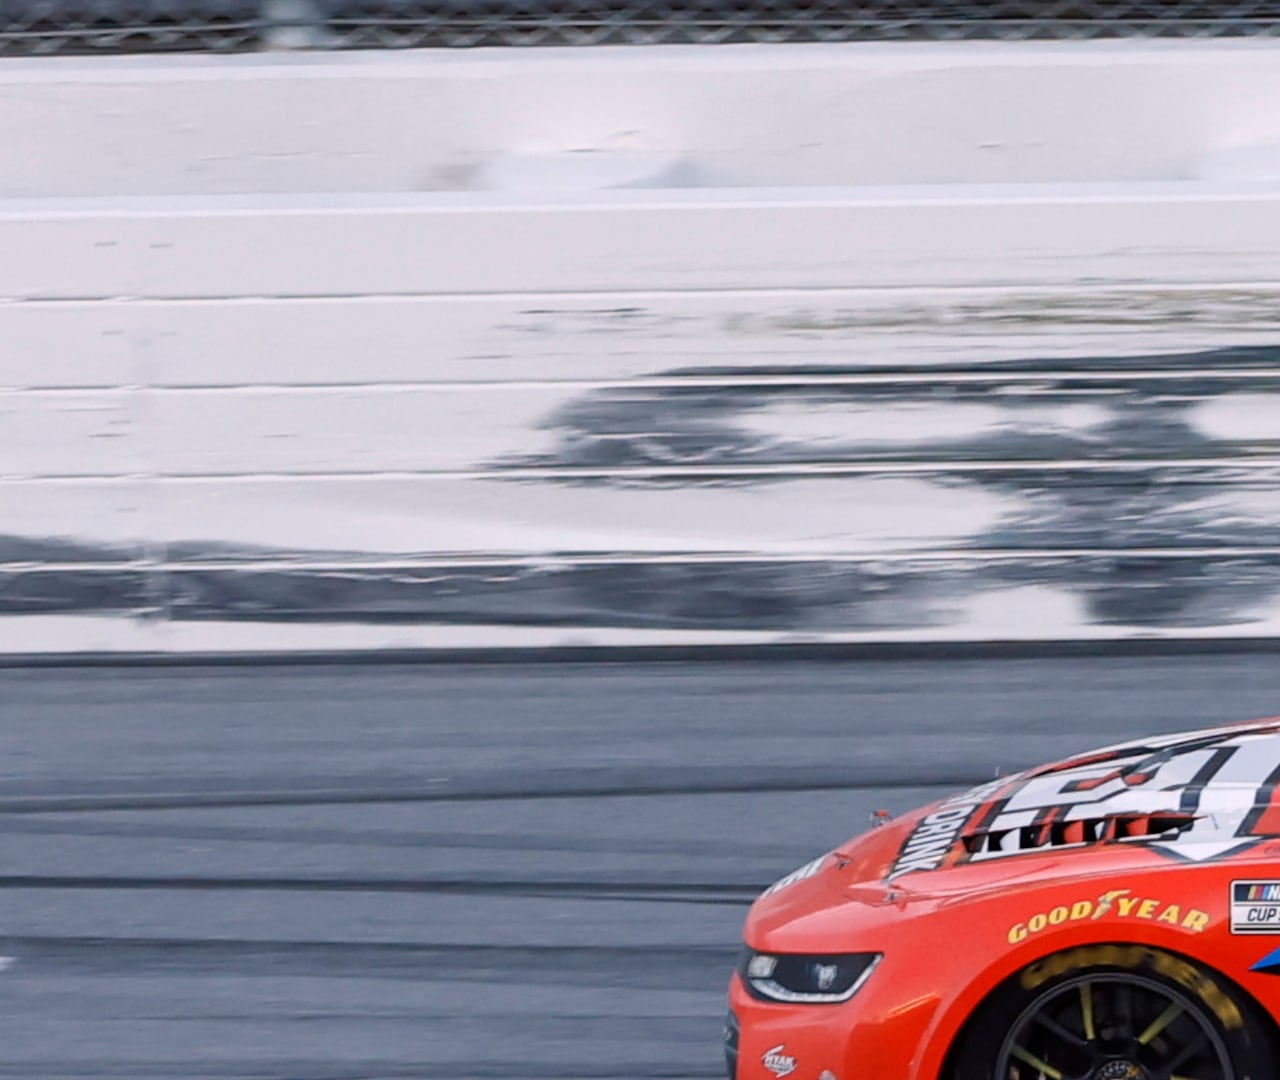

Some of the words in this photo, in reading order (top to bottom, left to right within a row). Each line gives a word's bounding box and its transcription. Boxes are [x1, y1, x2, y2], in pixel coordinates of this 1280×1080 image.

[887, 805, 976, 881] DRINK
[1008, 889, 1209, 944] GOODYEAR
[1247, 908, 1277, 922] CUP
